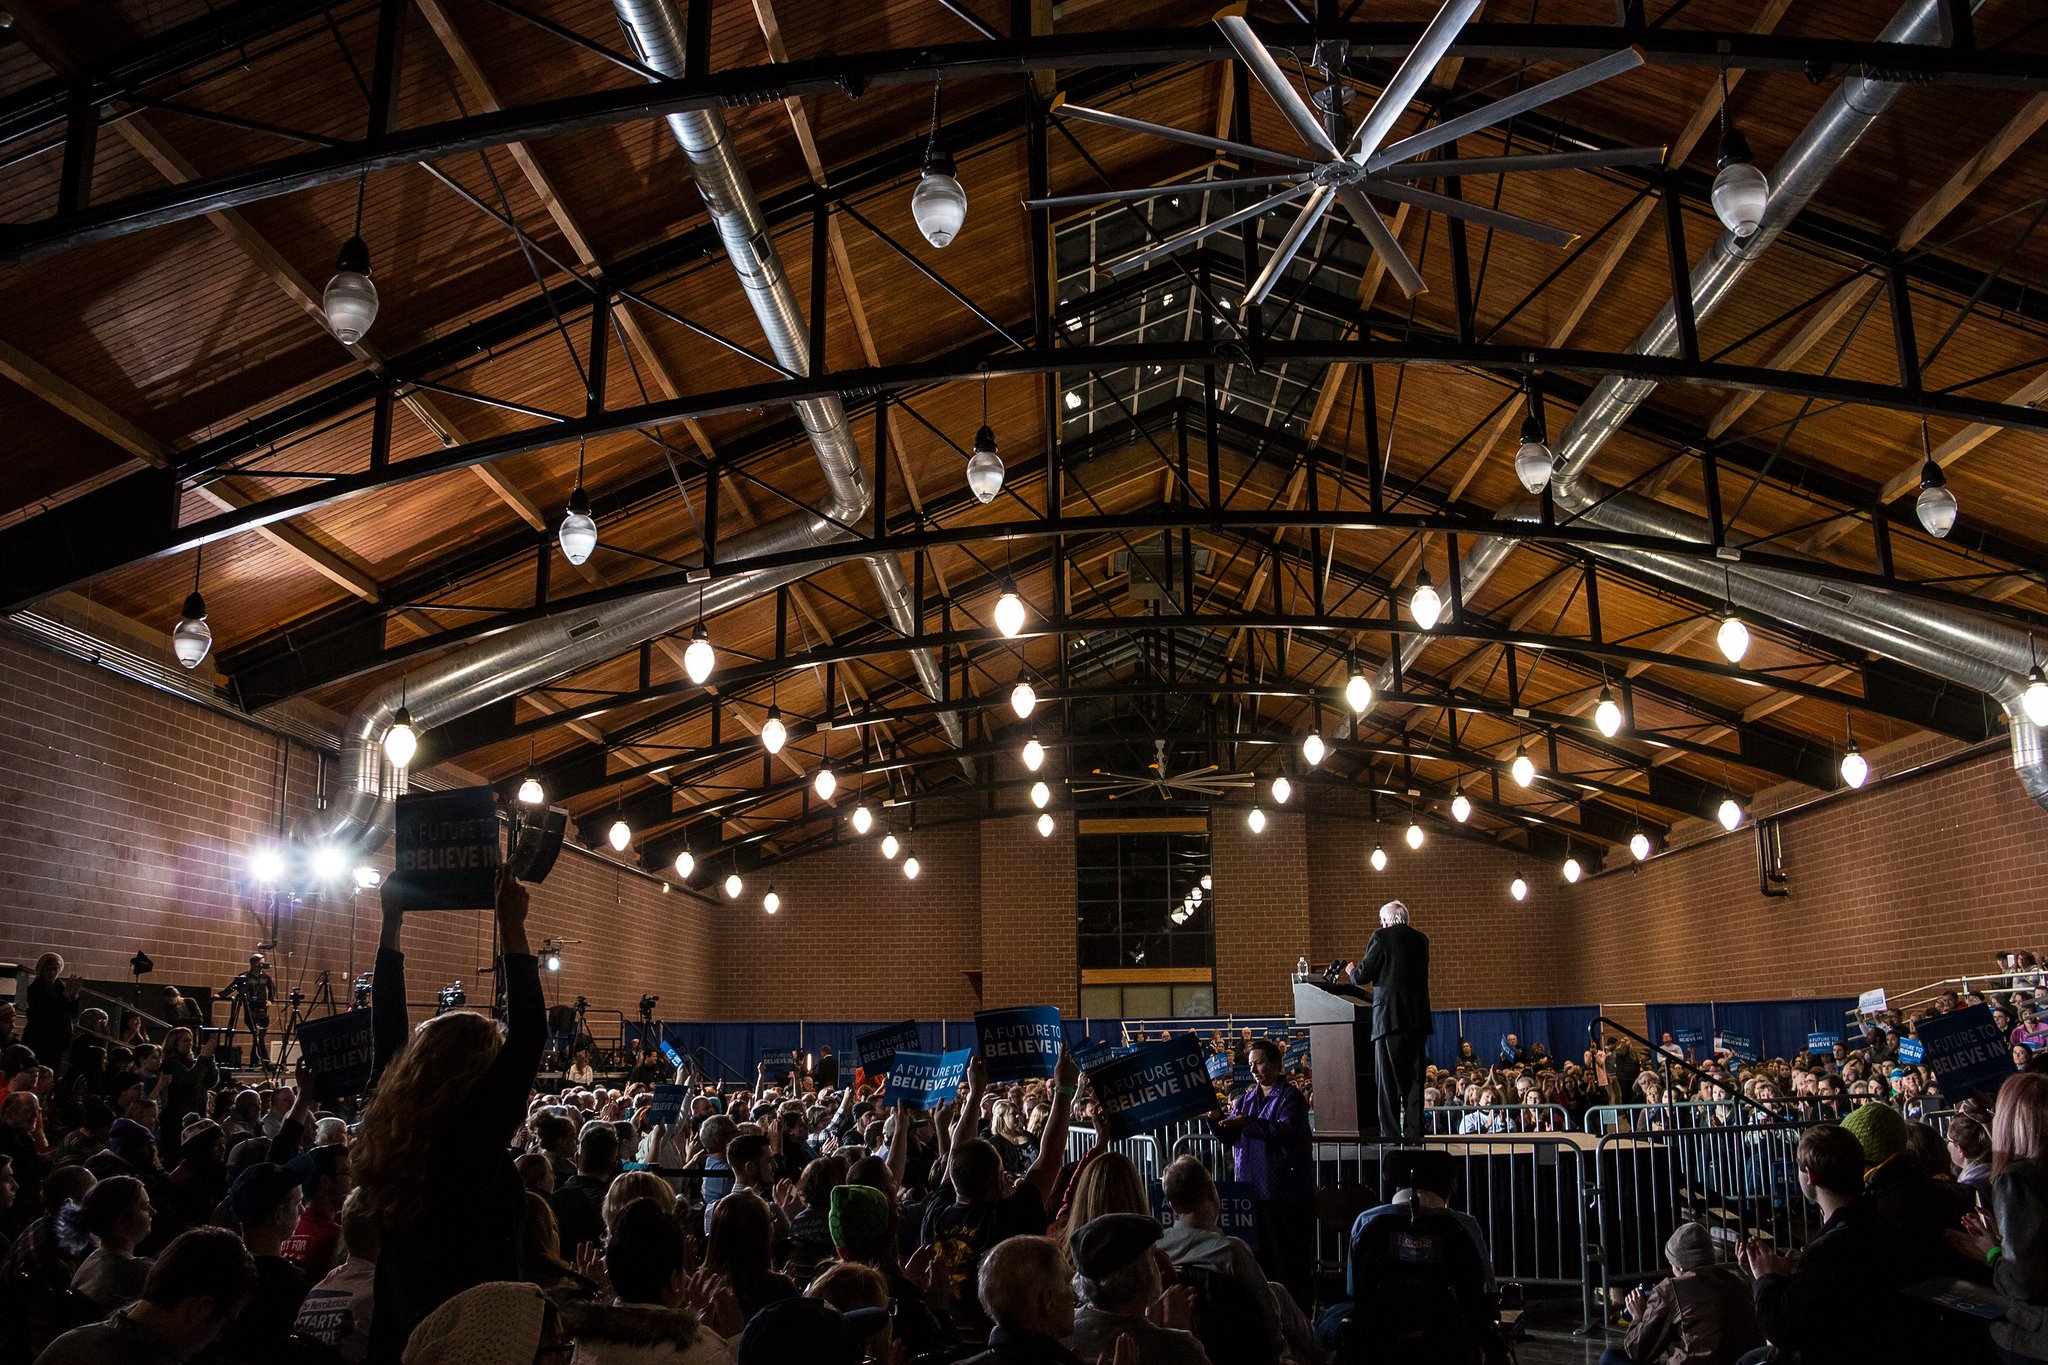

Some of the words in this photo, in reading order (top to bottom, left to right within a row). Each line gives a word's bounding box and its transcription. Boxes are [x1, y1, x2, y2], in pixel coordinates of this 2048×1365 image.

[404, 827, 414, 842] A
[419, 820, 475, 841] FUTURE
[402, 846, 479, 871] BELIEVE
[310, 1042, 320, 1055] A
[323, 1030, 369, 1051] FUTUR
[862, 1045, 869, 1053] A
[869, 1034, 905, 1051] FUTURE
[905, 1030, 916, 1039] TO
[984, 1029, 994, 1041] A
[997, 1024, 1050, 1040] FUTURE
[1050, 1025, 1061, 1038] TO
[1927, 1042, 1935, 1053] A
[1934, 1029, 1977, 1051] FUTURE
[1977, 1024, 1997, 1038] TO
[313, 1047, 371, 1073] BELIEV
[863, 1044, 906, 1063] BELIEVE
[907, 1039, 920, 1049] IN
[984, 1039, 1053, 1058] BELIEVE
[1932, 1045, 1987, 1075] BELIEVE
[1987, 1040, 2007, 1058] IN
[895, 1064, 904, 1074] A
[907, 1065, 950, 1078] FUTURE
[952, 1063, 964, 1074] TO
[1103, 1084, 1114, 1097] A
[1115, 1062, 1175, 1092] FUTURE
[1175, 1053, 1200, 1071] TO
[892, 1075, 947, 1091] BELIEVE
[947, 1075, 960, 1087] IN
[1107, 1078, 1182, 1114] BELIEVE
[1183, 1068, 1207, 1089] IN
[1231, 1199, 1252, 1211] TO
[1235, 1213, 1254, 1227] IN
